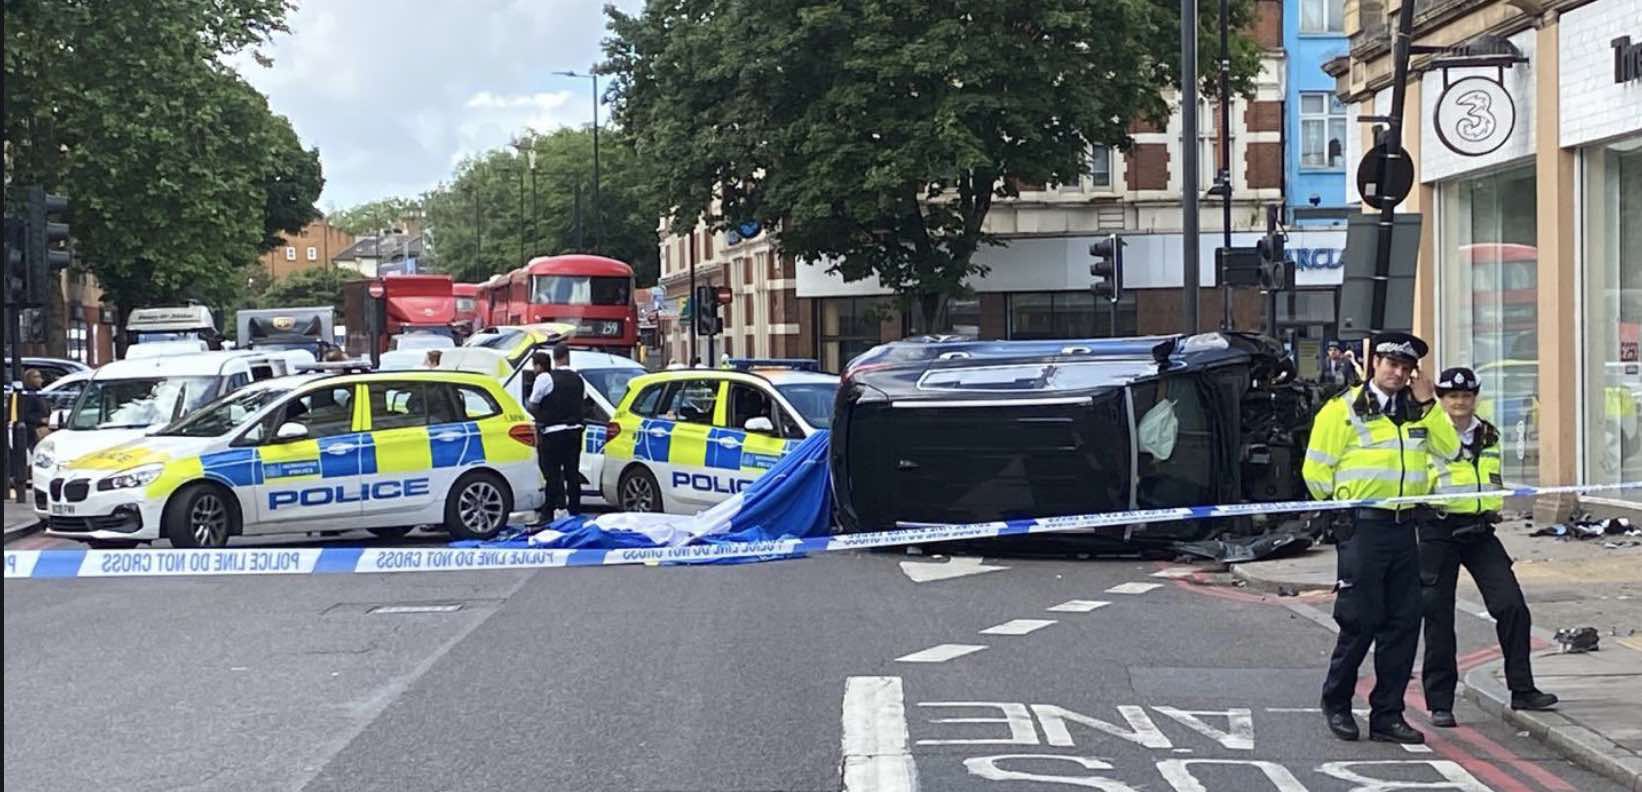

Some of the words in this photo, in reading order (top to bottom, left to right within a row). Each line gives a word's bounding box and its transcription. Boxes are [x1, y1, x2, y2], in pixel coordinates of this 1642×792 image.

[1456, 90, 1496, 142] 3
[269, 478, 430, 510] POLICE
[672, 471, 755, 494] POLIC
